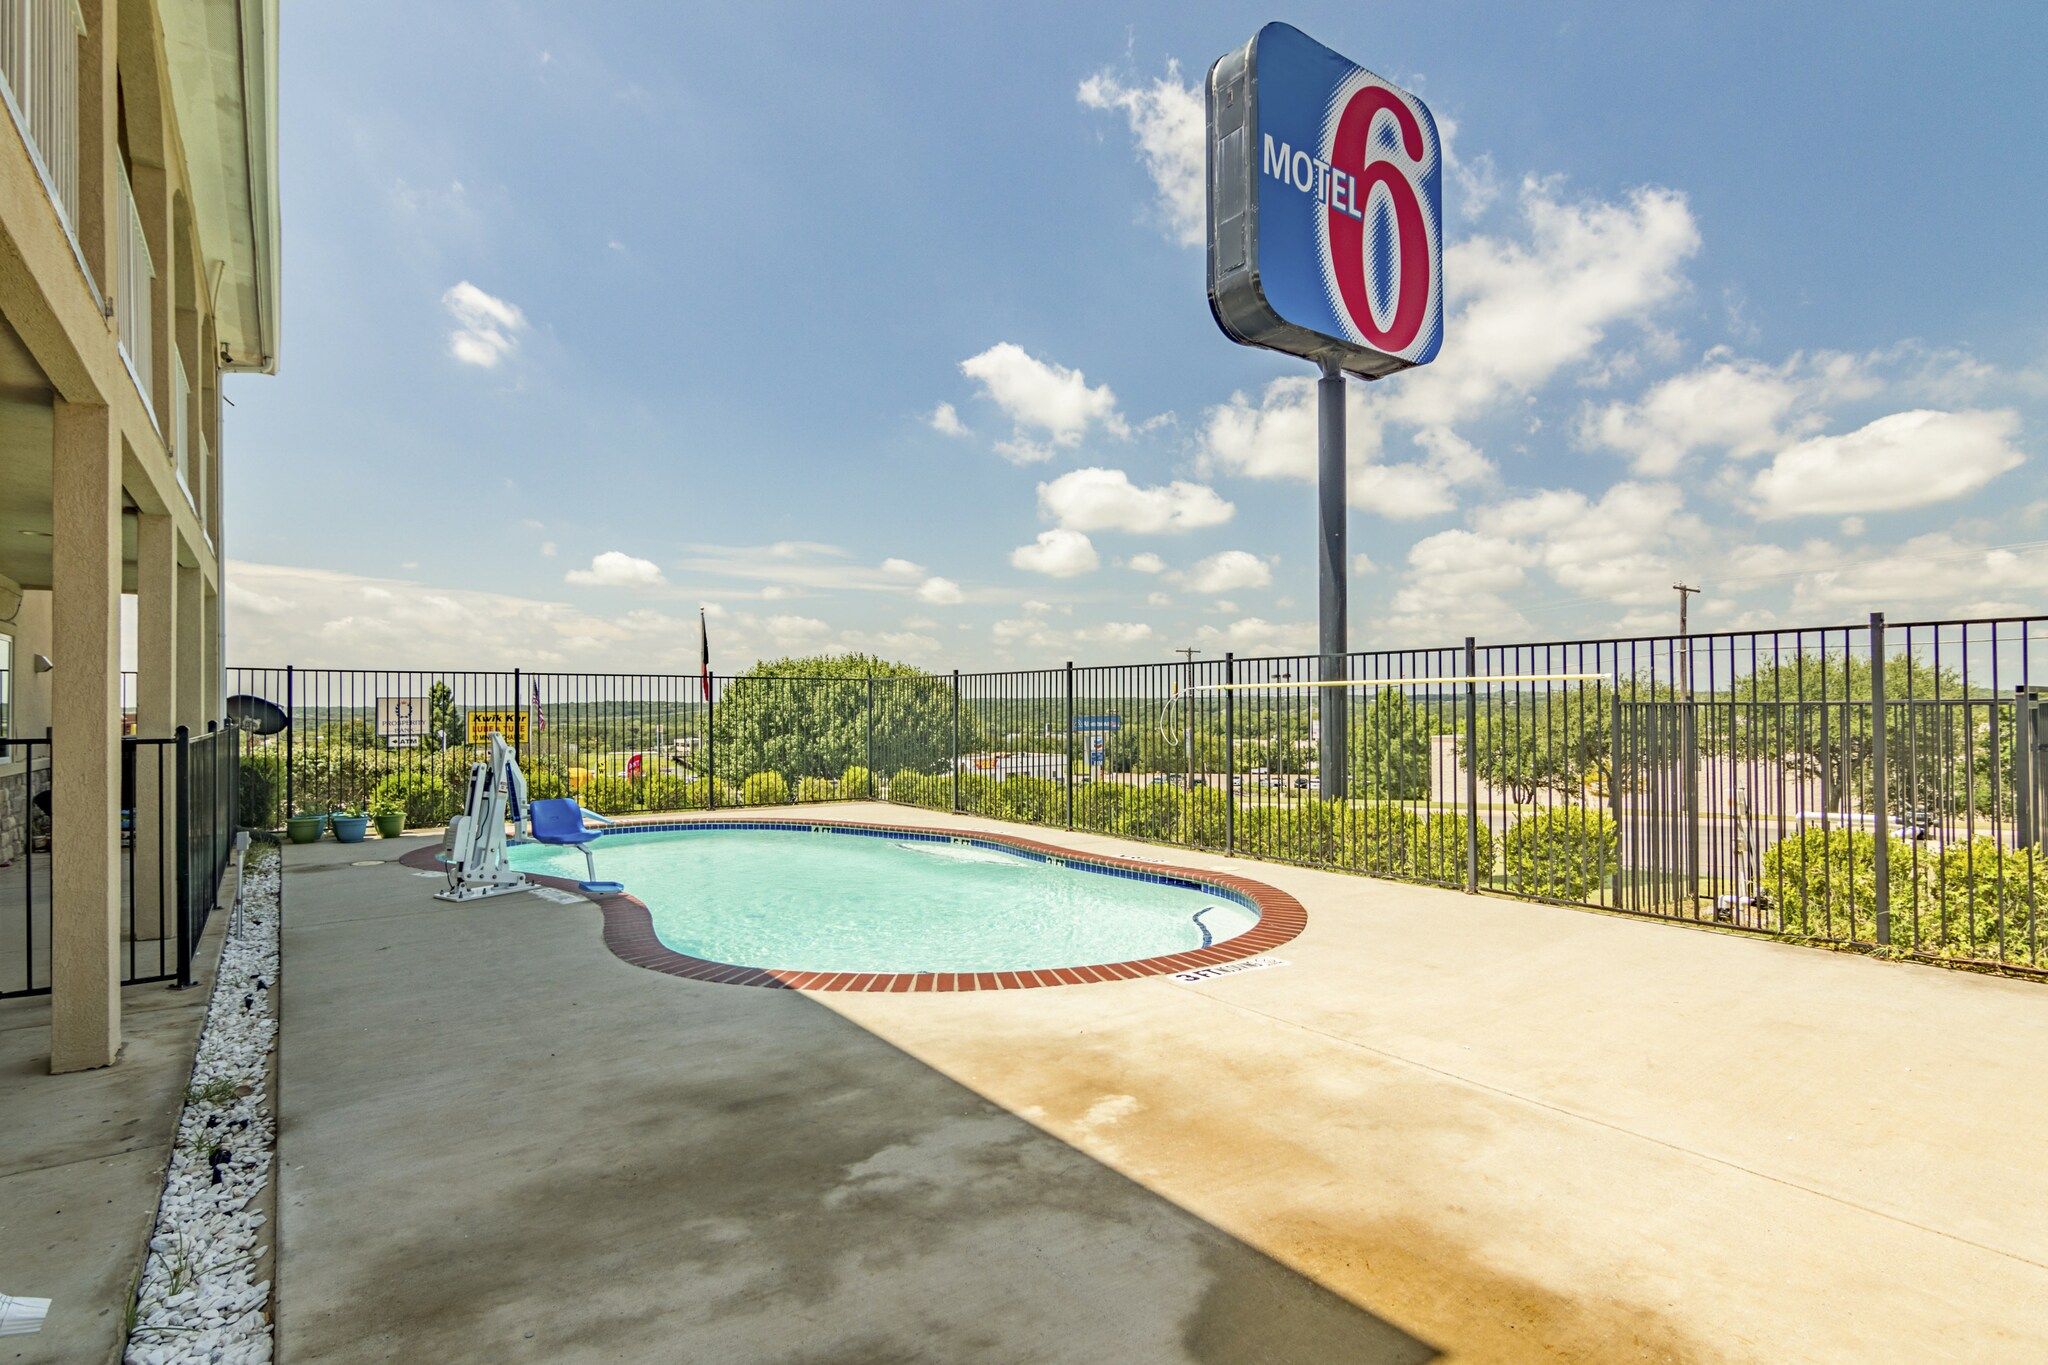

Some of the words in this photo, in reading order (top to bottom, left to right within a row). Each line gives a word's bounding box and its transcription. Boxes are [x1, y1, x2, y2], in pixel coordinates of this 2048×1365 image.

[1263, 133, 1363, 218] MOTEL
[1328, 85, 1430, 353] 6
[473, 714, 502, 722] Kwik
[505, 714, 526, 722] Kr
[1176, 973, 1200, 981] 3
[1193, 969, 1222, 978] FT
